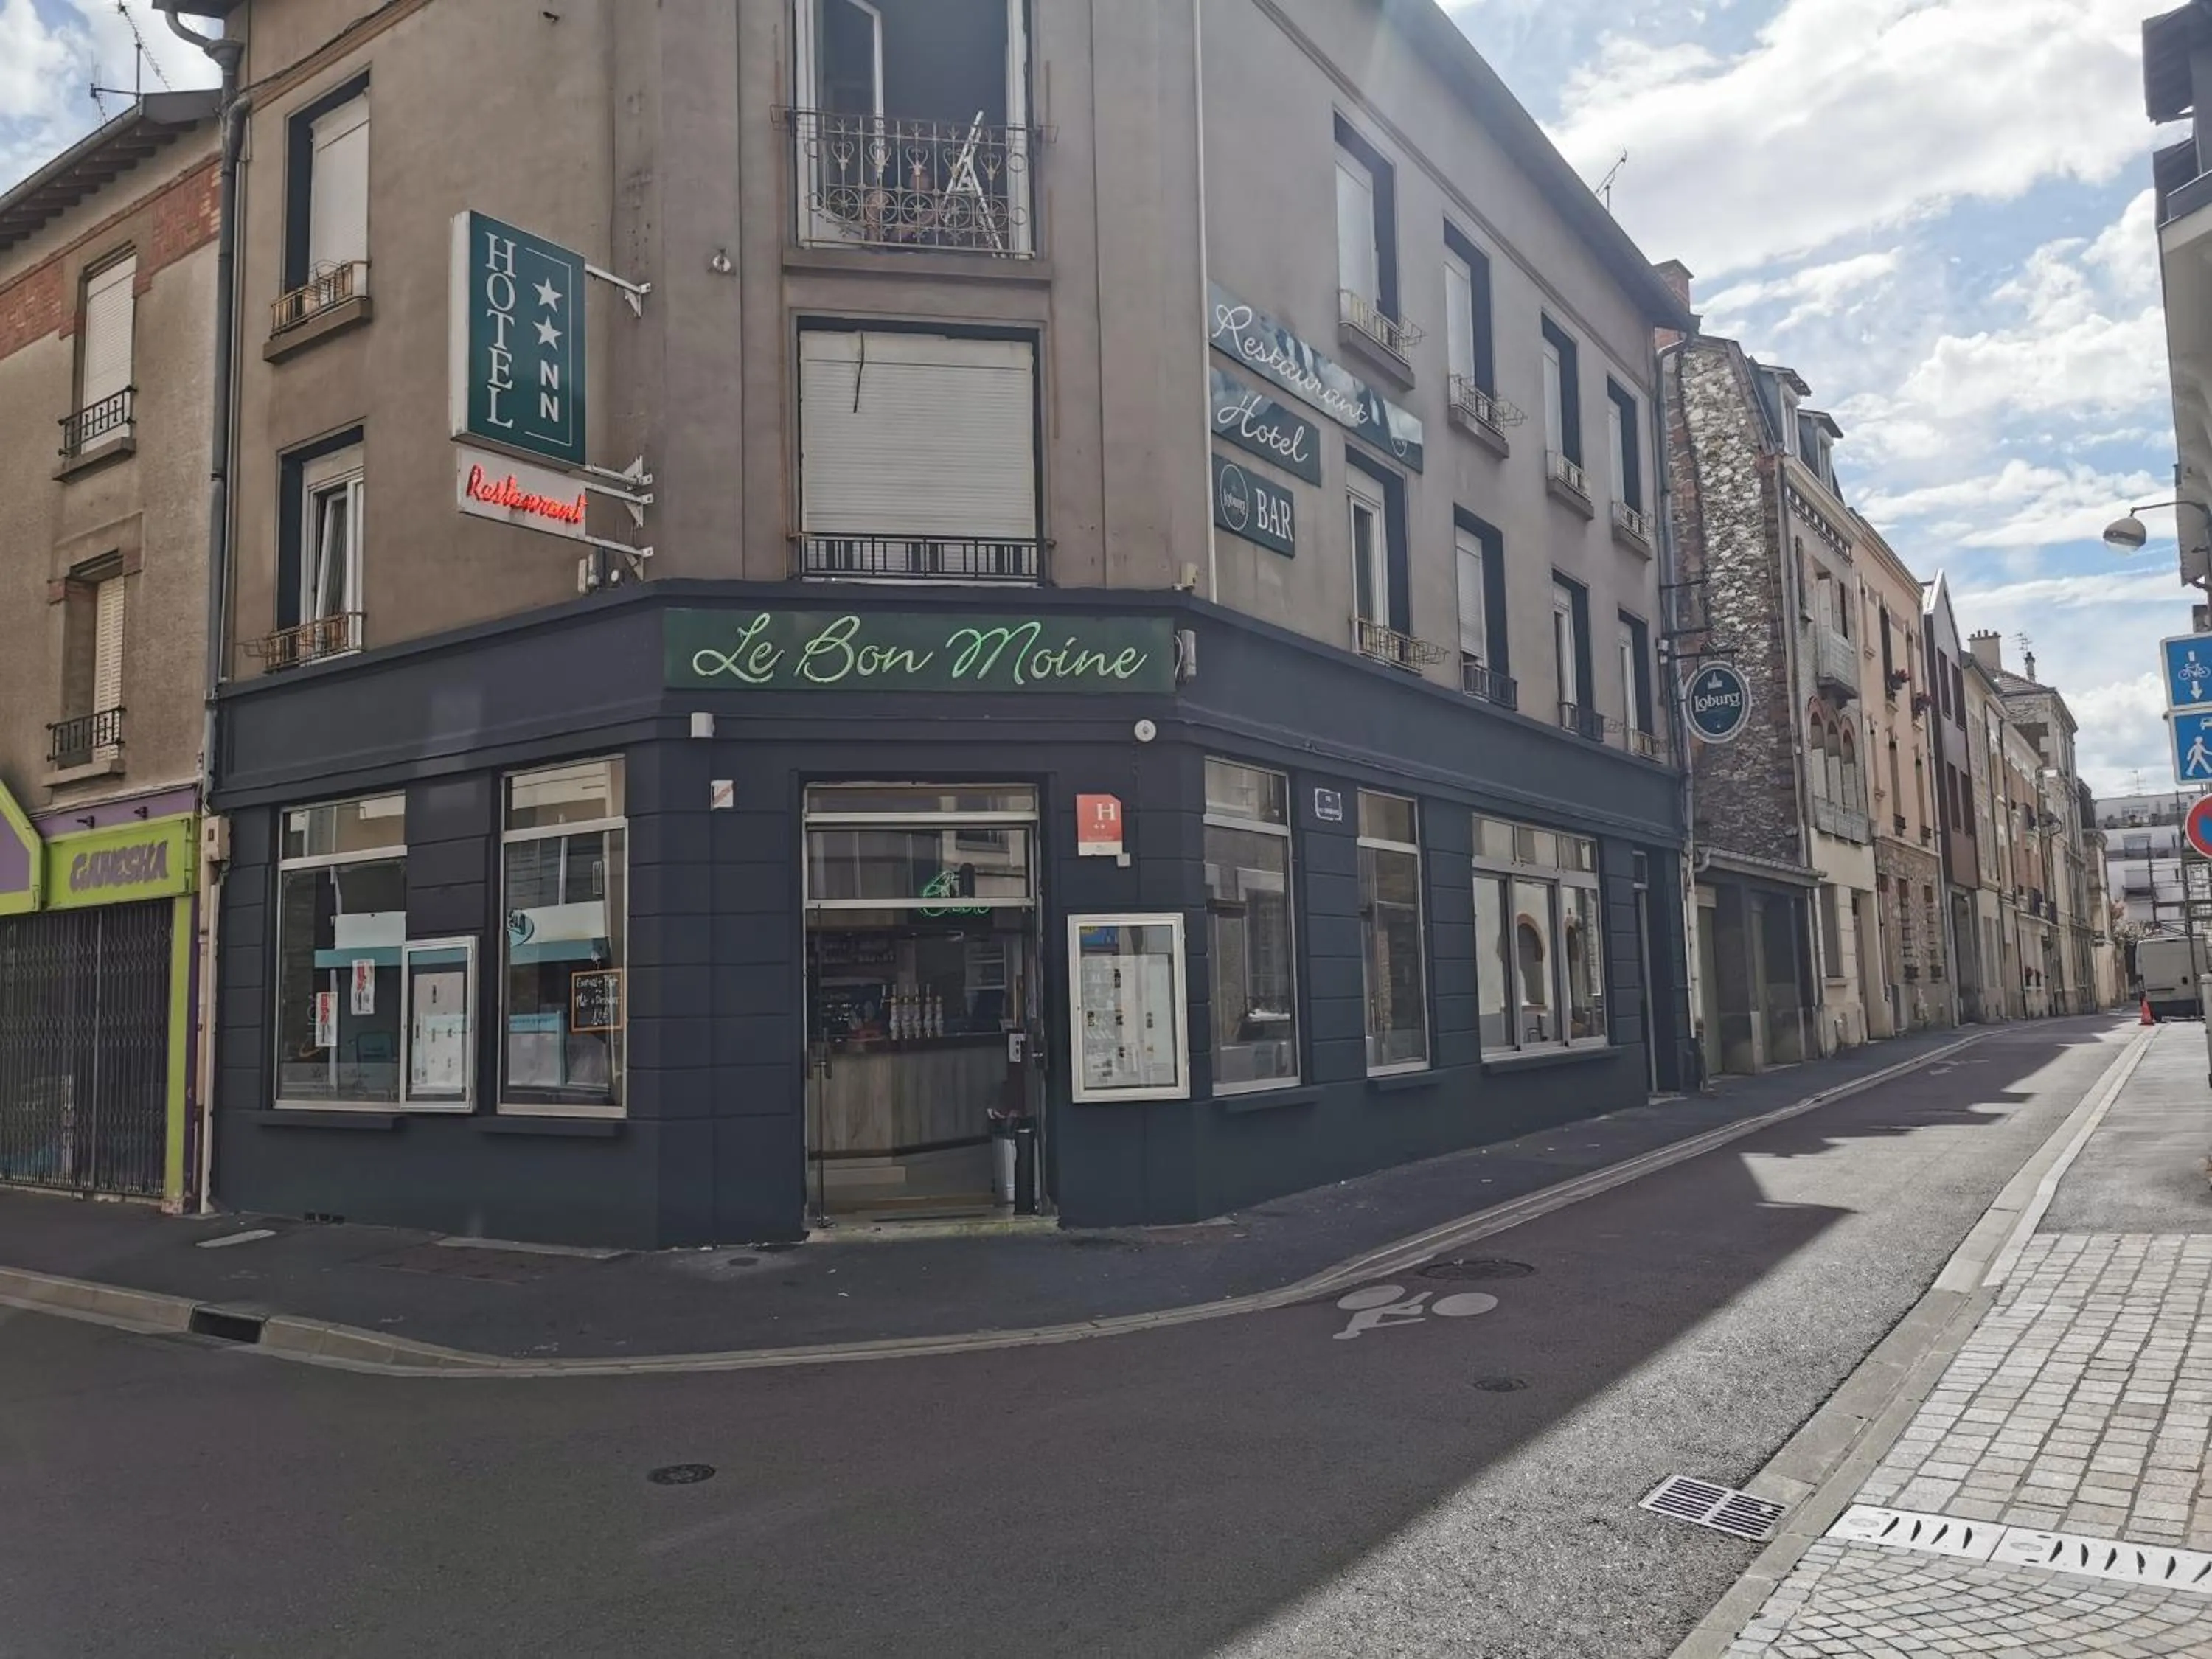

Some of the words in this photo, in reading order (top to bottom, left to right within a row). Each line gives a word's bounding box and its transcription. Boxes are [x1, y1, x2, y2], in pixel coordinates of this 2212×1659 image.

[485, 232, 516, 429] HOTEL
[1211, 304, 1369, 425] Restaurant
[1217, 394, 1308, 463] Hotel
[466, 464, 588, 524] Restaurant
[1256, 487, 1294, 542] BAR
[692, 612, 785, 683] Le
[793, 615, 934, 684] Bon
[945, 621, 1149, 686] Moine
[1096, 803, 1116, 821] H
[70, 840, 168, 893] GANESHA
